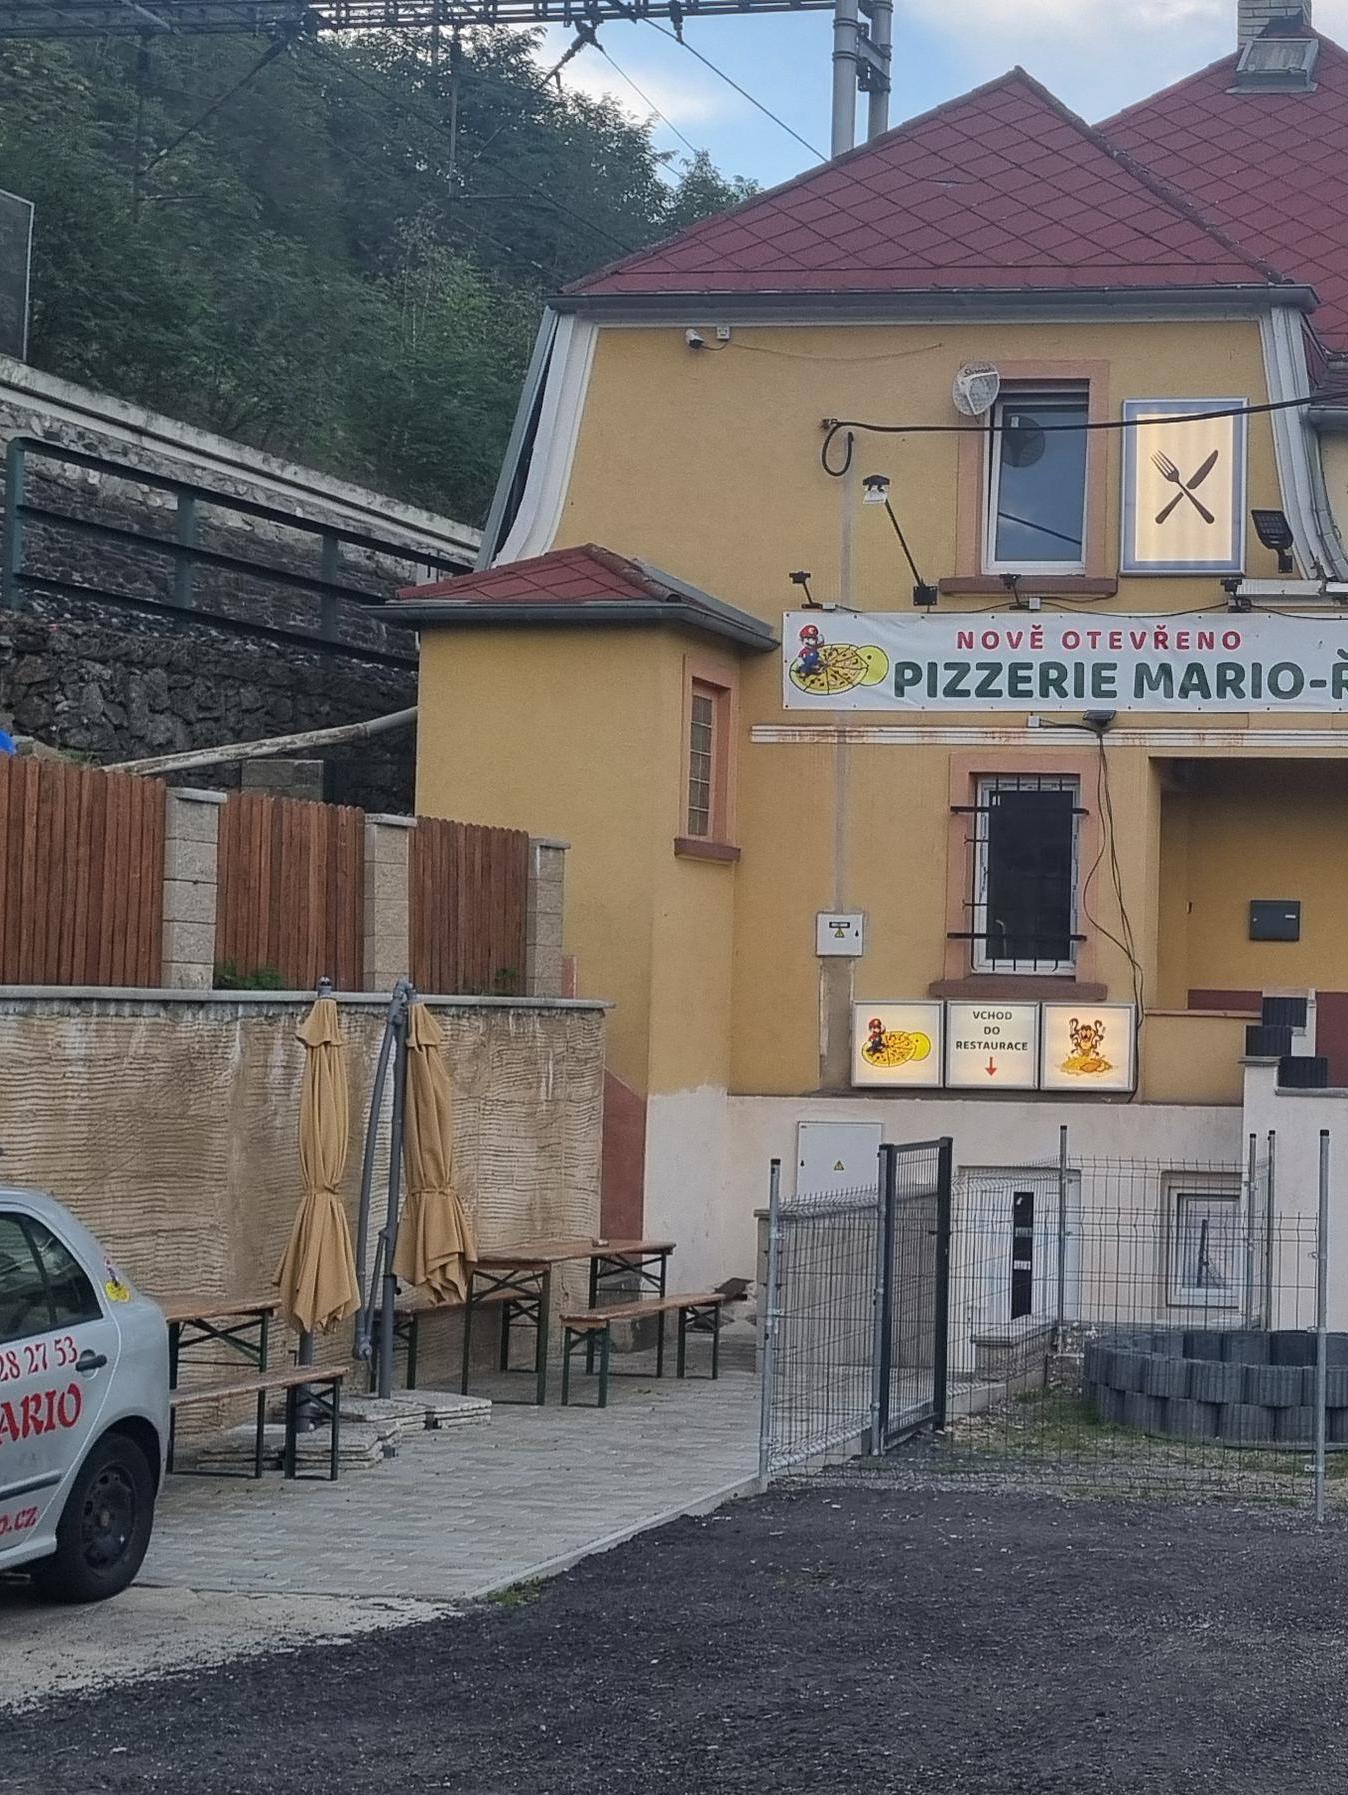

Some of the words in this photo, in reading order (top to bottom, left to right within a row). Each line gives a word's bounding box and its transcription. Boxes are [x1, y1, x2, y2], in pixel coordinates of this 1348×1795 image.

[956, 624, 1043, 650] NOVĚ
[1061, 624, 1242, 651] OTEVŘENO
[894, 661, 1118, 699] PIZZERIE
[972, 1010, 1013, 1021] VCHOD
[983, 1026, 1001, 1036] DO
[955, 1040, 1029, 1052] RESTAURACE
[24, 1342, 48, 1375] 27
[54, 1336, 78, 1367] 53
[0, 1382, 82, 1445] ARIO
